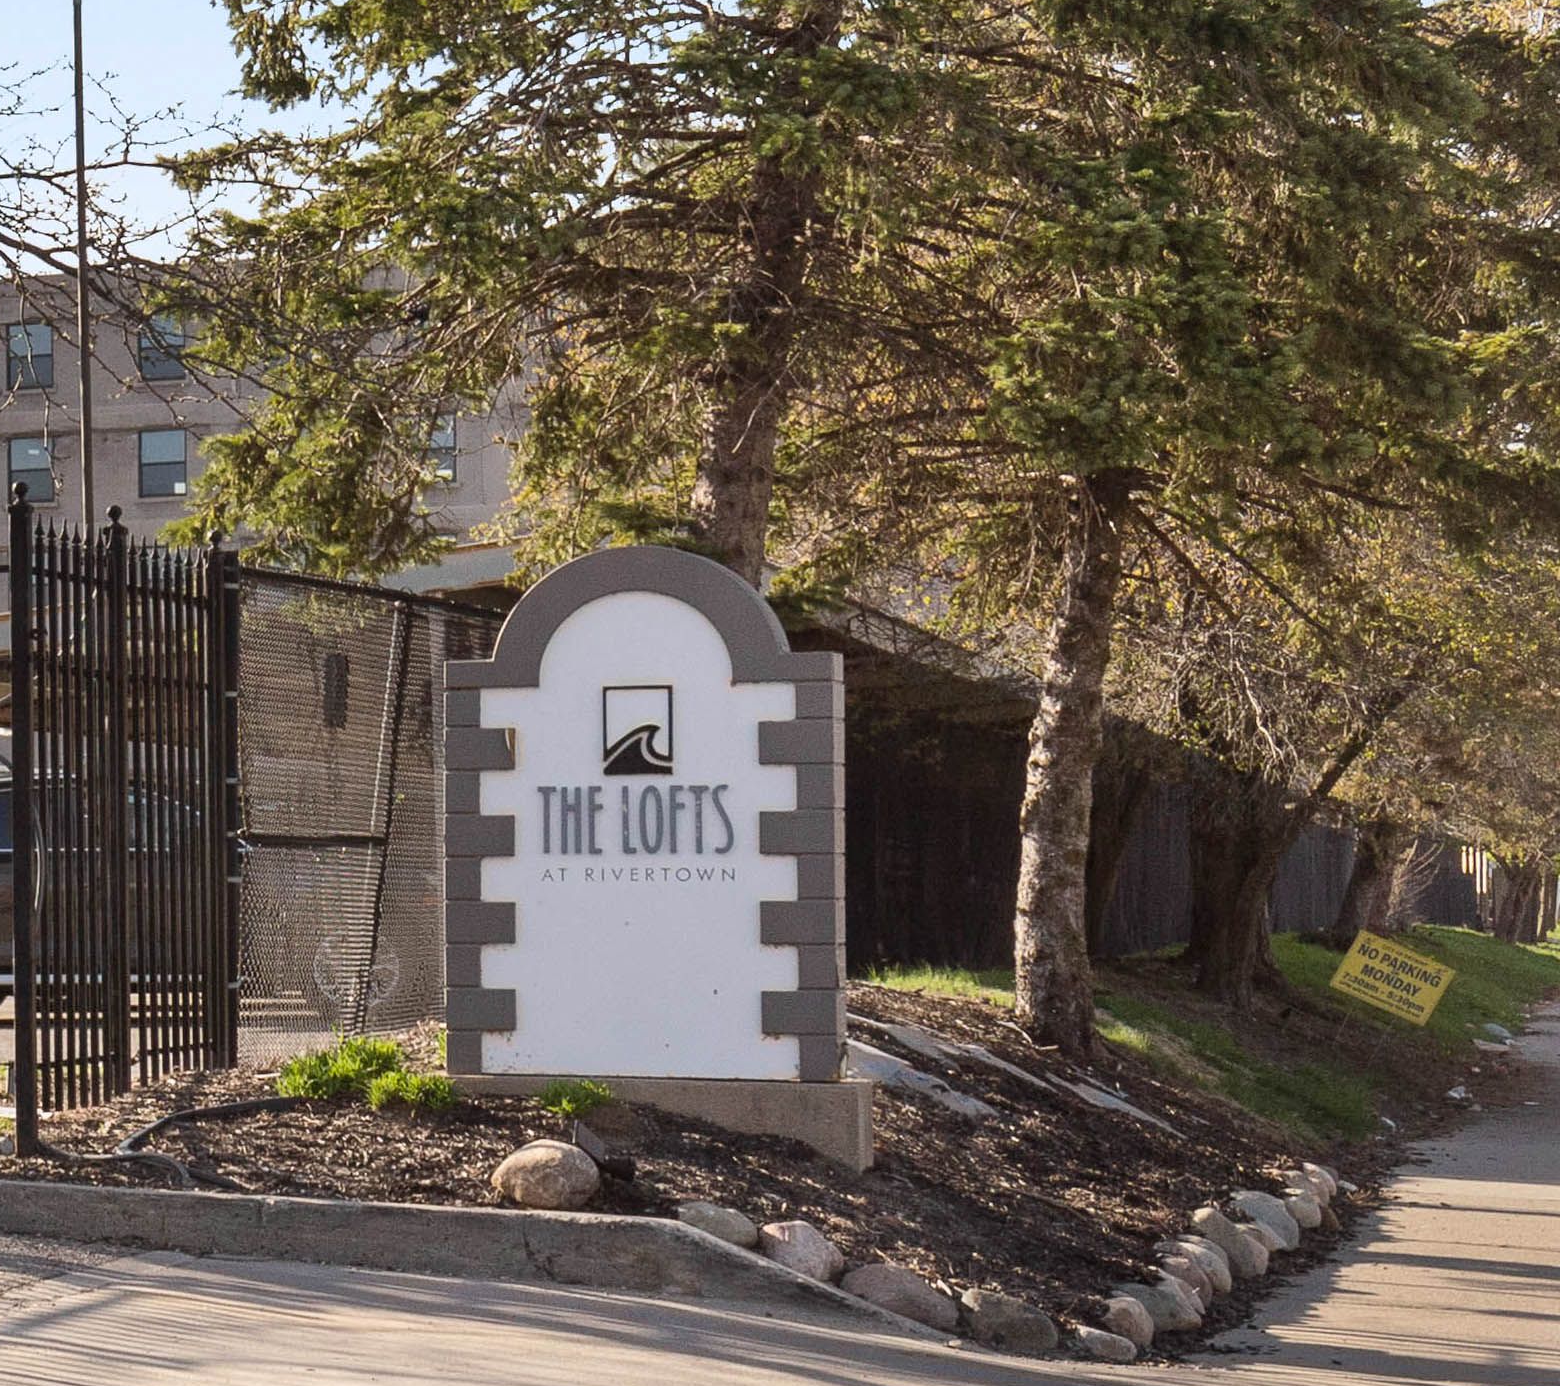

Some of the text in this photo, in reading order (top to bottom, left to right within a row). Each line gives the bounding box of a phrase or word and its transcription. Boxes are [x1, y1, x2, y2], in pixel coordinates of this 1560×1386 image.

[537, 784, 734, 855] THE LOFTS
[541, 867, 736, 883] AT RIVERTOWN
[1358, 944, 1379, 960] NO
[1380, 953, 1441, 987] PARKING
[1361, 964, 1421, 996] MONDAY
